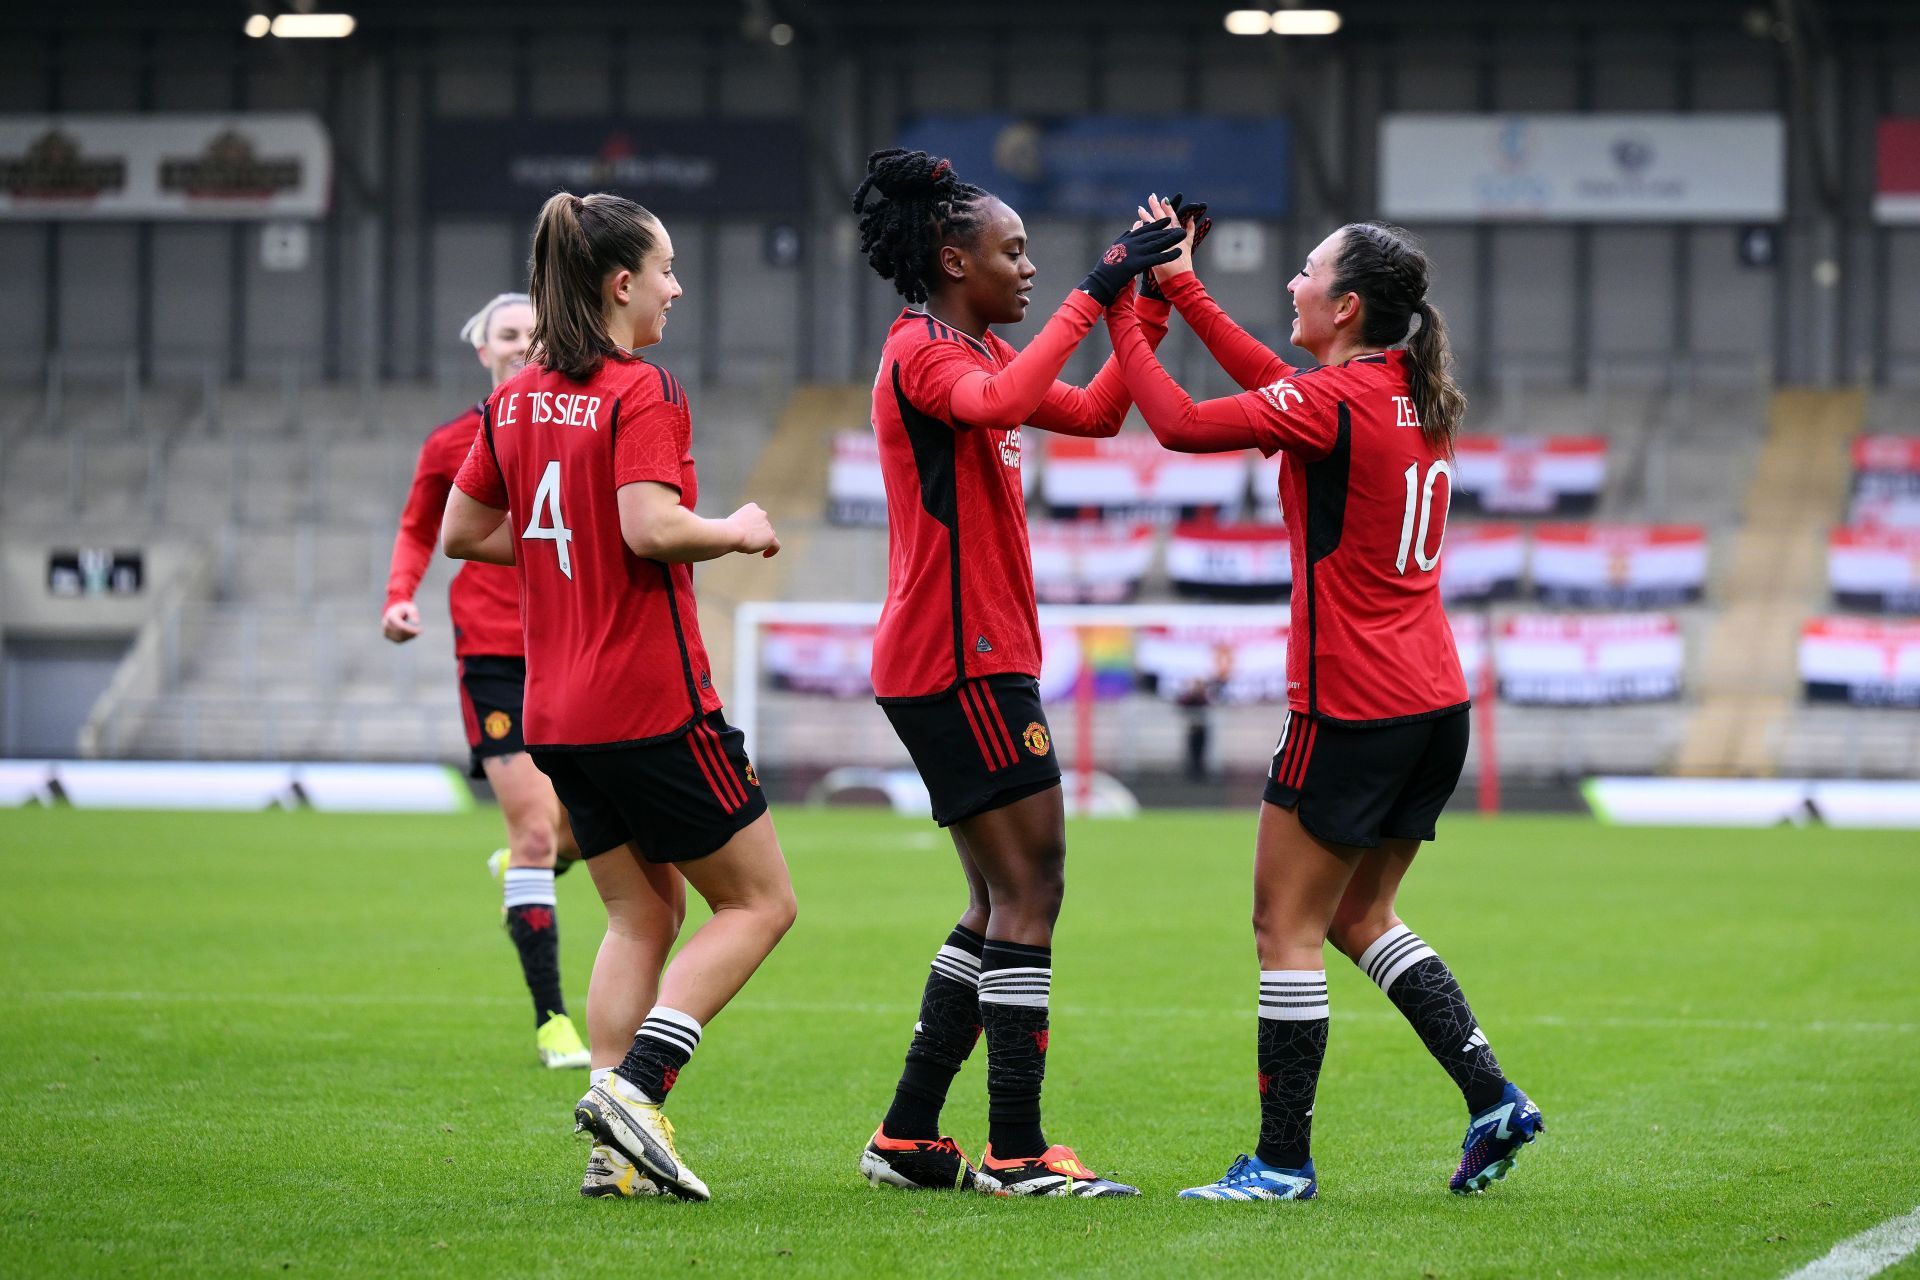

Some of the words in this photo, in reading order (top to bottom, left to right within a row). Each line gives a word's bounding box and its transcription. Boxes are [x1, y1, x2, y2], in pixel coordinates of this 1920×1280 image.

[497, 392, 519, 428] LE
[527, 391, 601, 432] TISSIER
[521, 460, 571, 581] 4
[1395, 459, 1452, 576] 10
